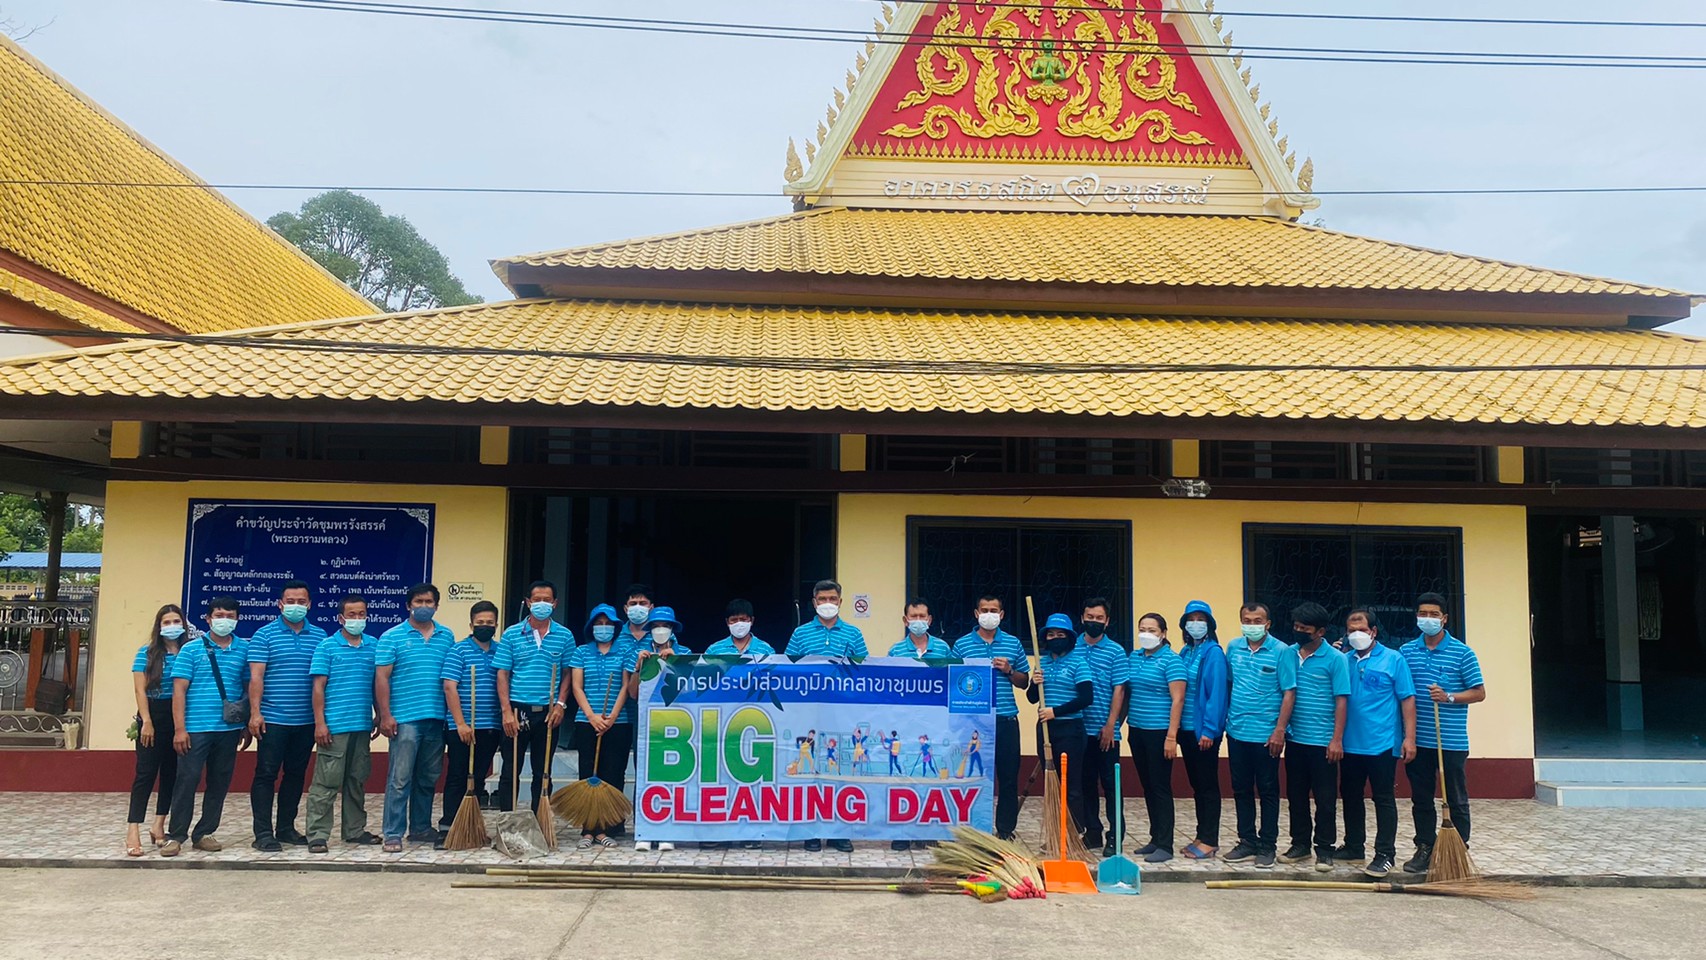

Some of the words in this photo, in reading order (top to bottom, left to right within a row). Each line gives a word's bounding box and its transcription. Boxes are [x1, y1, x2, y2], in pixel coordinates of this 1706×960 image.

[236, 516, 386, 531] คำขวัญประจำวัดชุมพรรังสรรค์
[271, 533, 348, 545] (พระอารามหลวง)
[215, 554, 244, 566] วัดน่าอยู่
[364, 585, 410, 595] เน้นพร้อมหน้
[675, 671, 944, 697] การประปาส่วนภูมิภาคสาขาชุมพร
[646, 705, 777, 785] BIG
[641, 784, 867, 824] CLEANING
[886, 786, 982, 825] DAY
